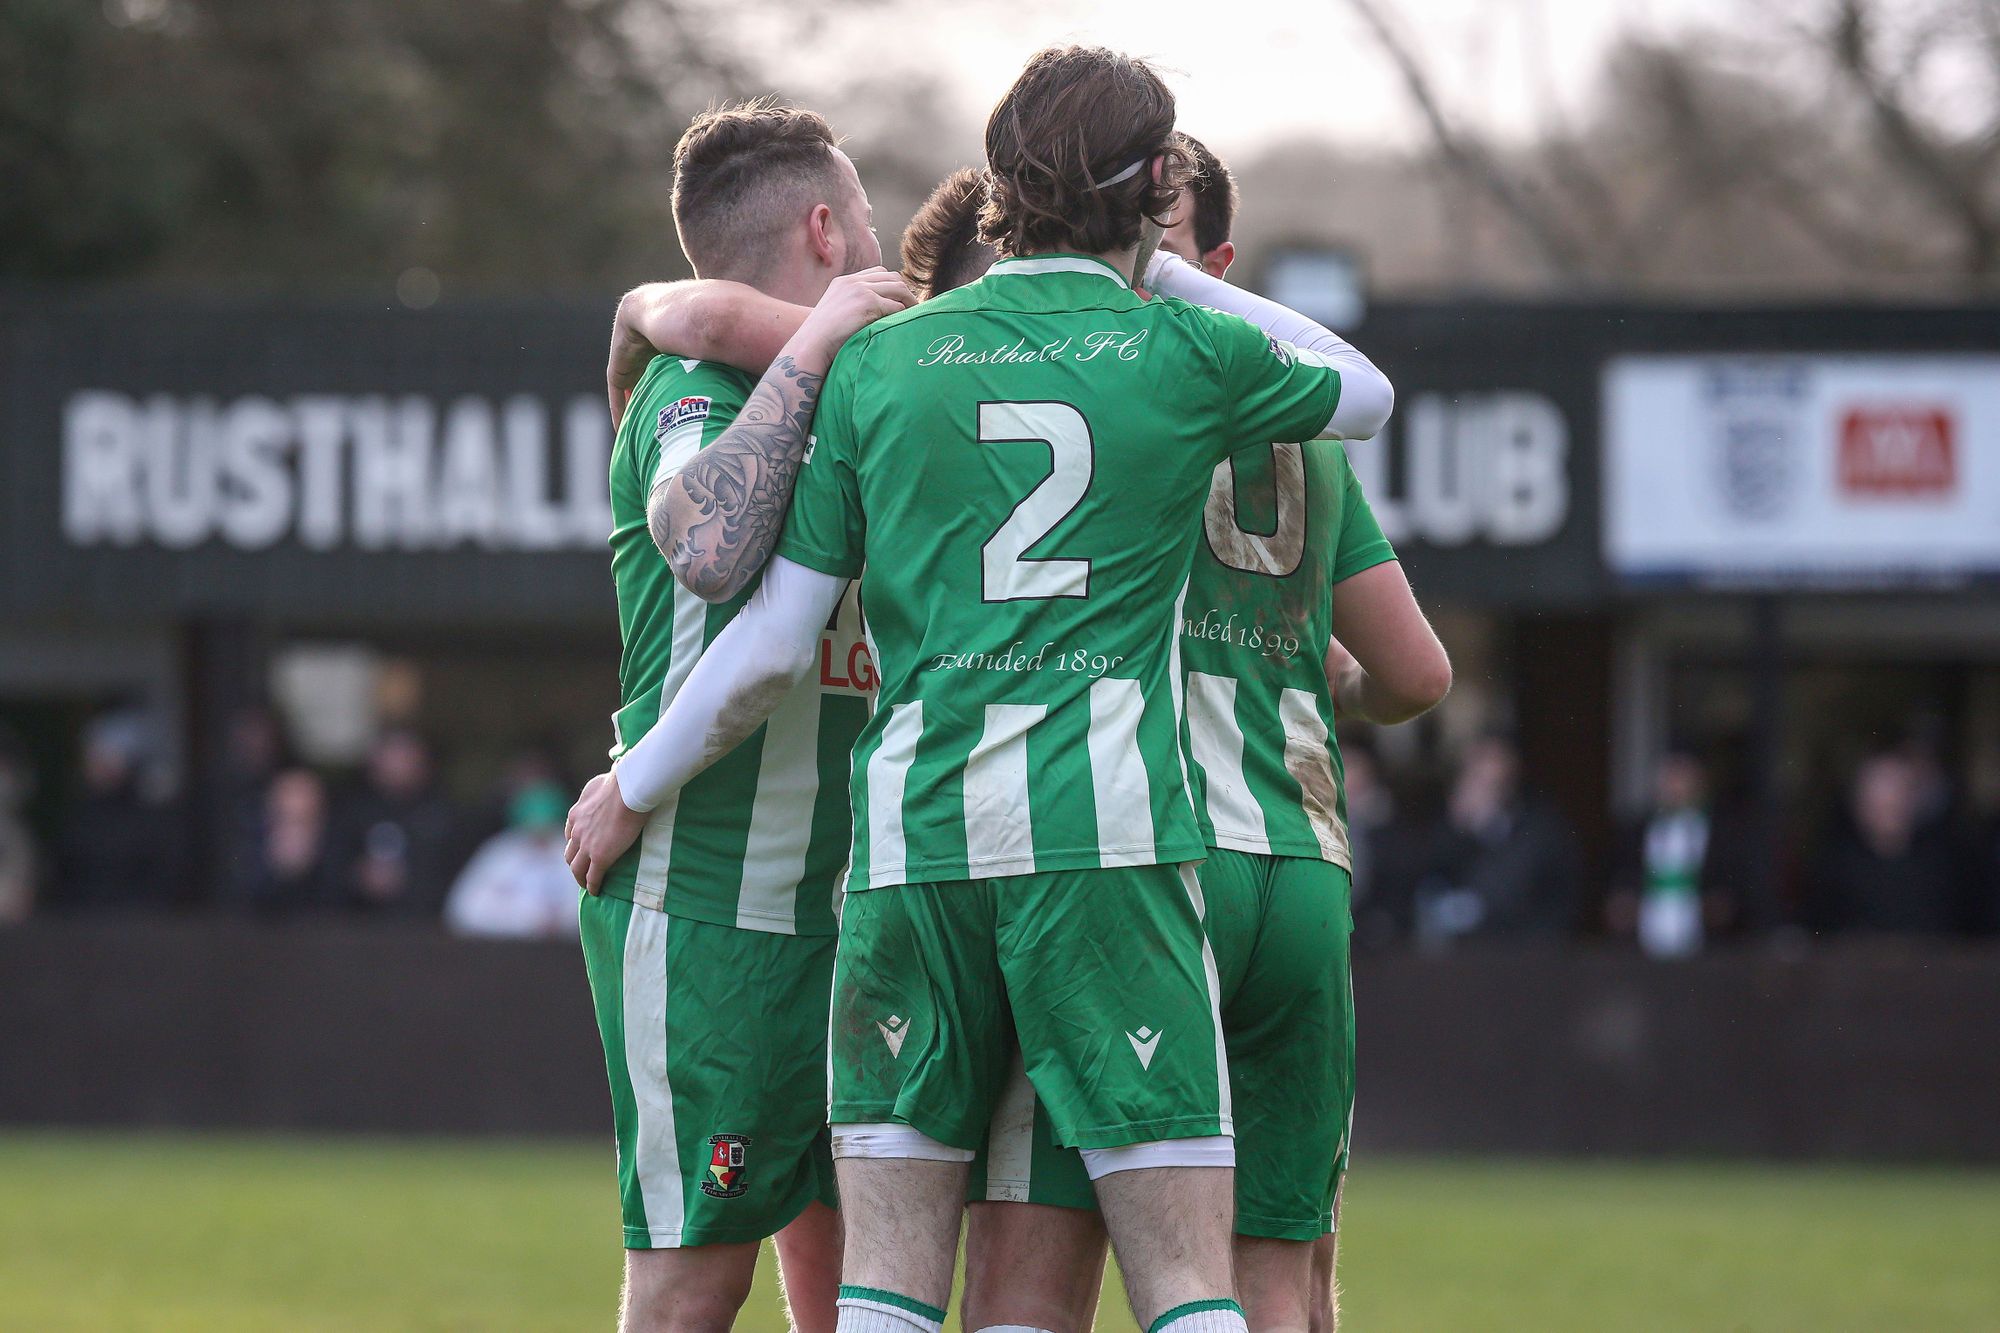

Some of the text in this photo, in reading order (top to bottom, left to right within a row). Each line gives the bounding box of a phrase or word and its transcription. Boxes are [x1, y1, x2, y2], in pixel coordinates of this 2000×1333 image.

[1075, 328, 1148, 362] FC
[64, 390, 1570, 548] RUSTHALL LUB
[977, 401, 1095, 604] 2
[1181, 608, 1299, 659] nded 1899
[820, 638, 880, 691] LG
